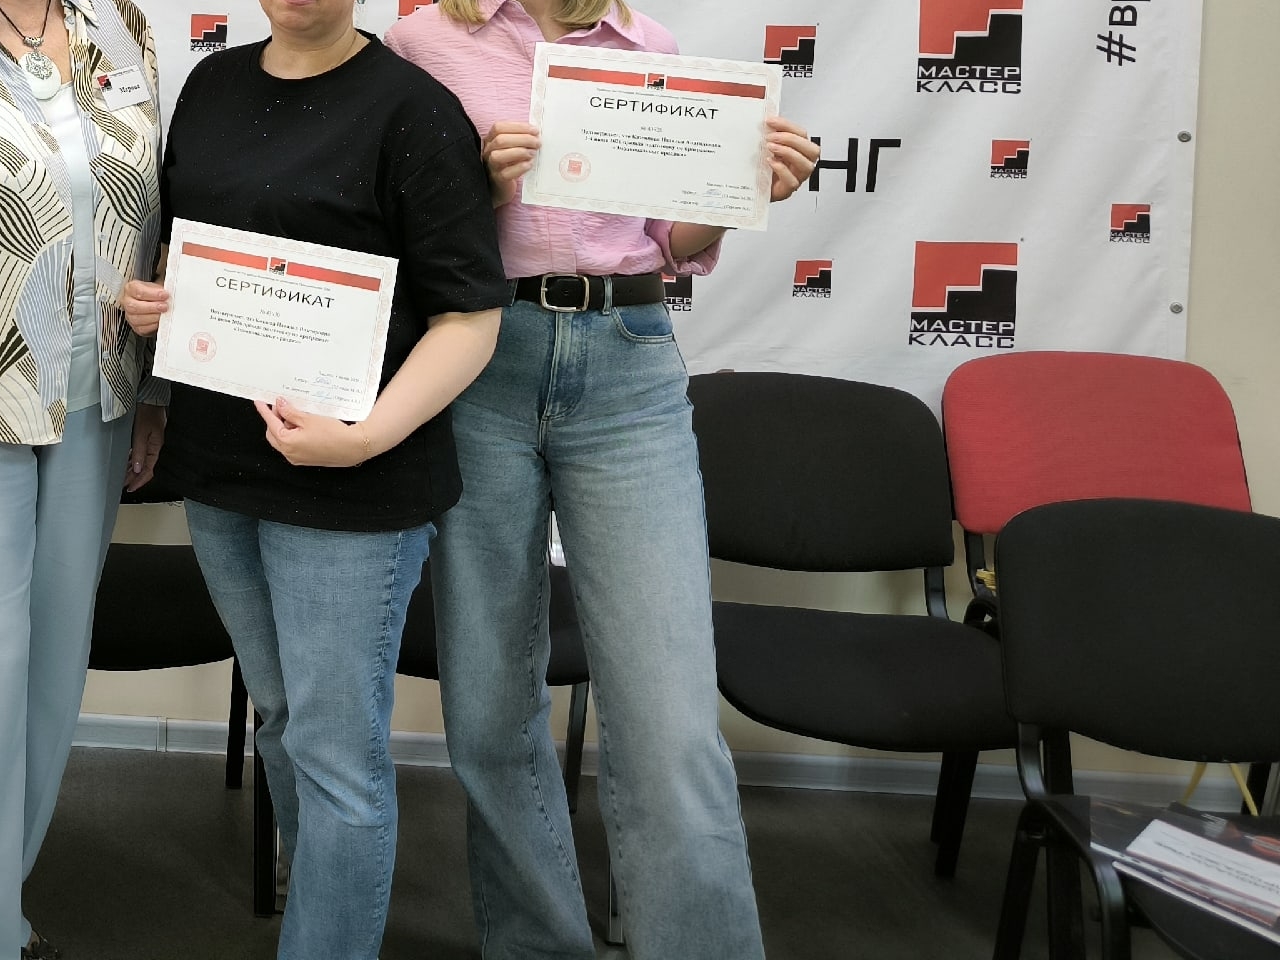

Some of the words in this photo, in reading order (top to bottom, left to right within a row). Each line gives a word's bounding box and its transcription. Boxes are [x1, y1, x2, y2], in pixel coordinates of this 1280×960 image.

[917, 67, 1021, 81] МАСТЕР
[917, 81, 1021, 94] КЛАСС
[589, 96, 720, 120] СЕРТИФИКАТ
[215, 276, 335, 309] СЕРТИФИКАТ
[910, 319, 1014, 333] МАСТЕР
[909, 333, 1014, 348] КЛАСС
